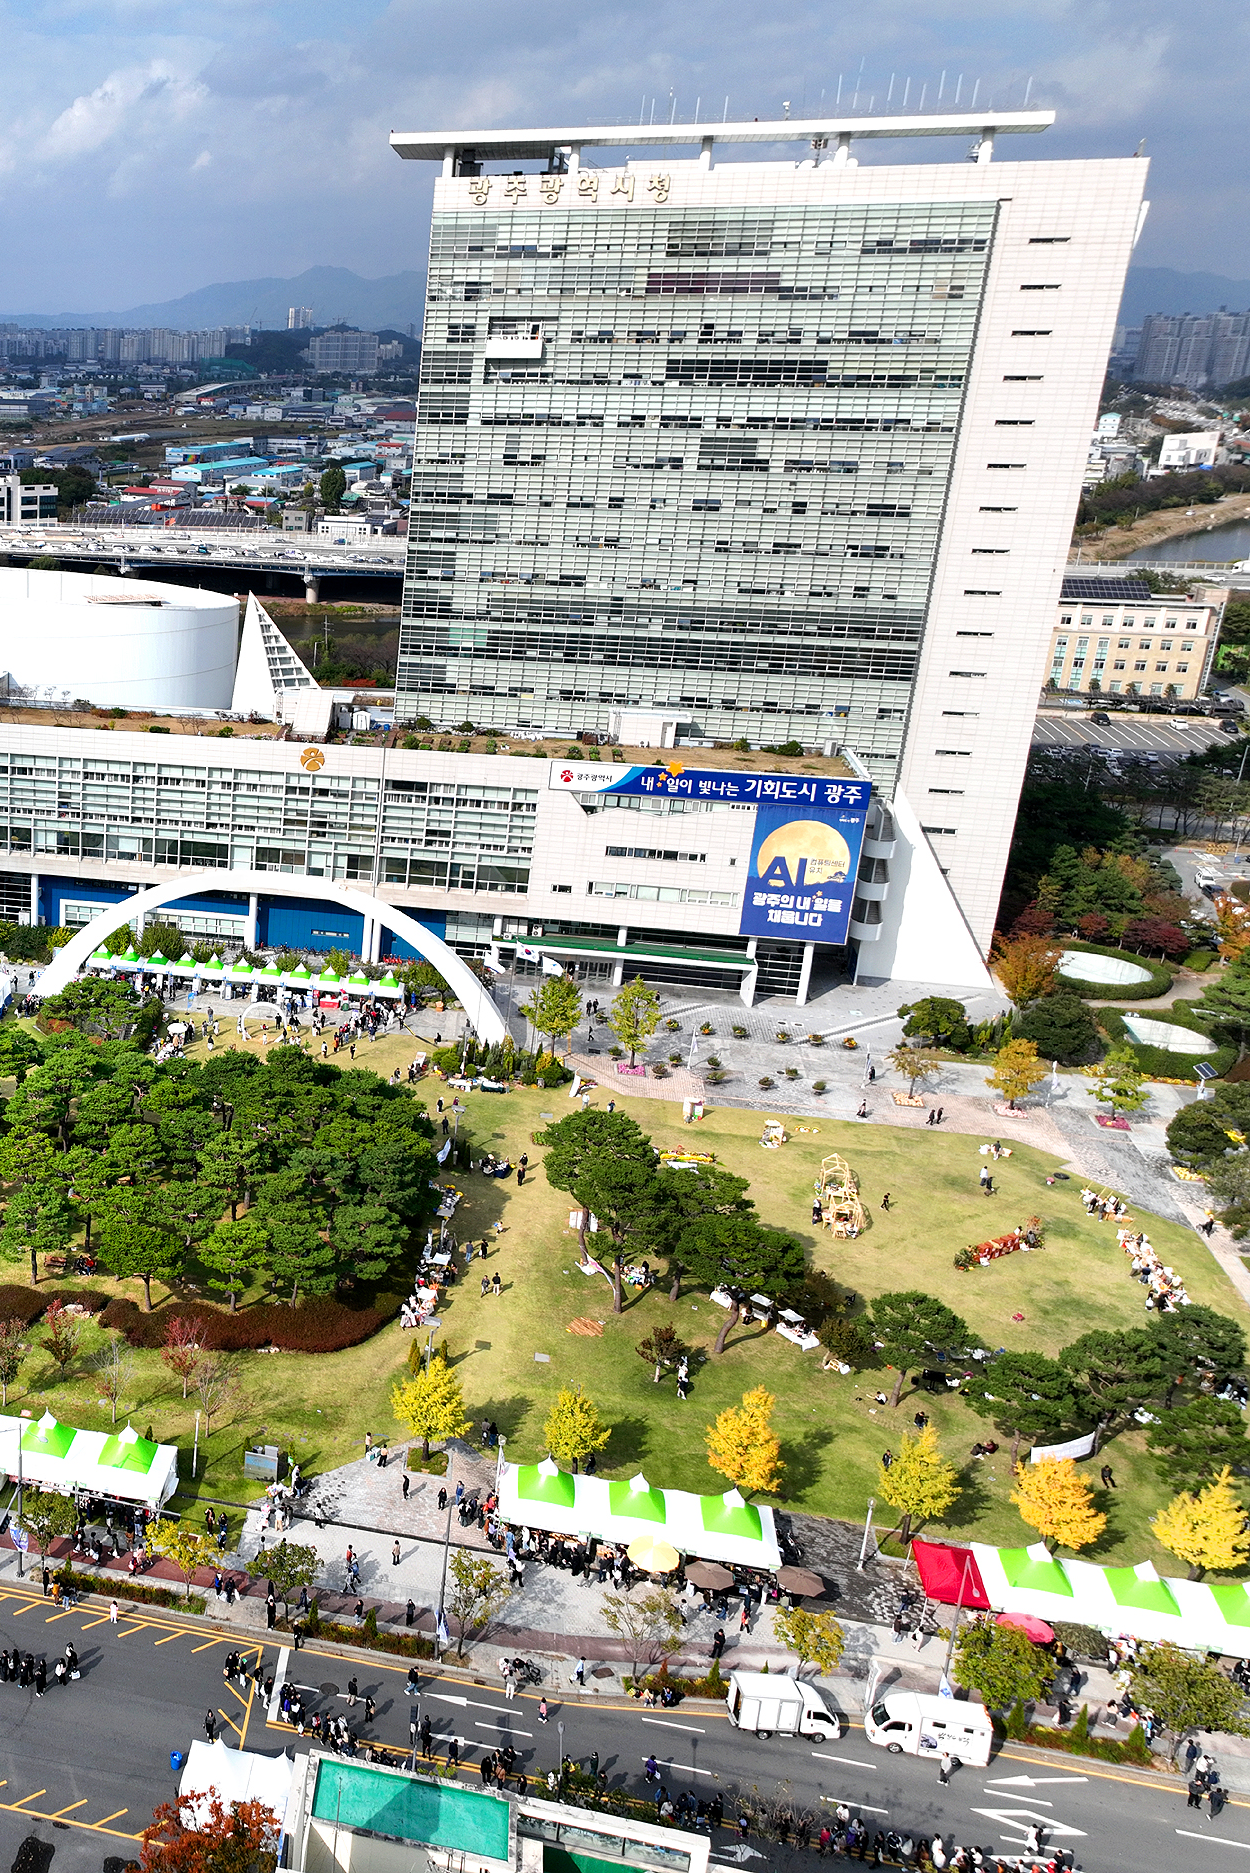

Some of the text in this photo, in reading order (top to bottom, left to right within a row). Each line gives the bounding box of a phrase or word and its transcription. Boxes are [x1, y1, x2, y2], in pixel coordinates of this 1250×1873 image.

[468, 175, 671, 205] 광주광역시청
[577, 773, 612, 783] 광주광역시
[698, 780, 740, 797] 빛나는
[745, 779, 817, 802] 기회도시
[824, 784, 863, 805] 광주
[759, 856, 808, 887] AI
[810, 859, 846, 868] 컴퓨팅센터
[752, 892, 795, 909] 광주의
[767, 909, 824, 927] 채웁니다
